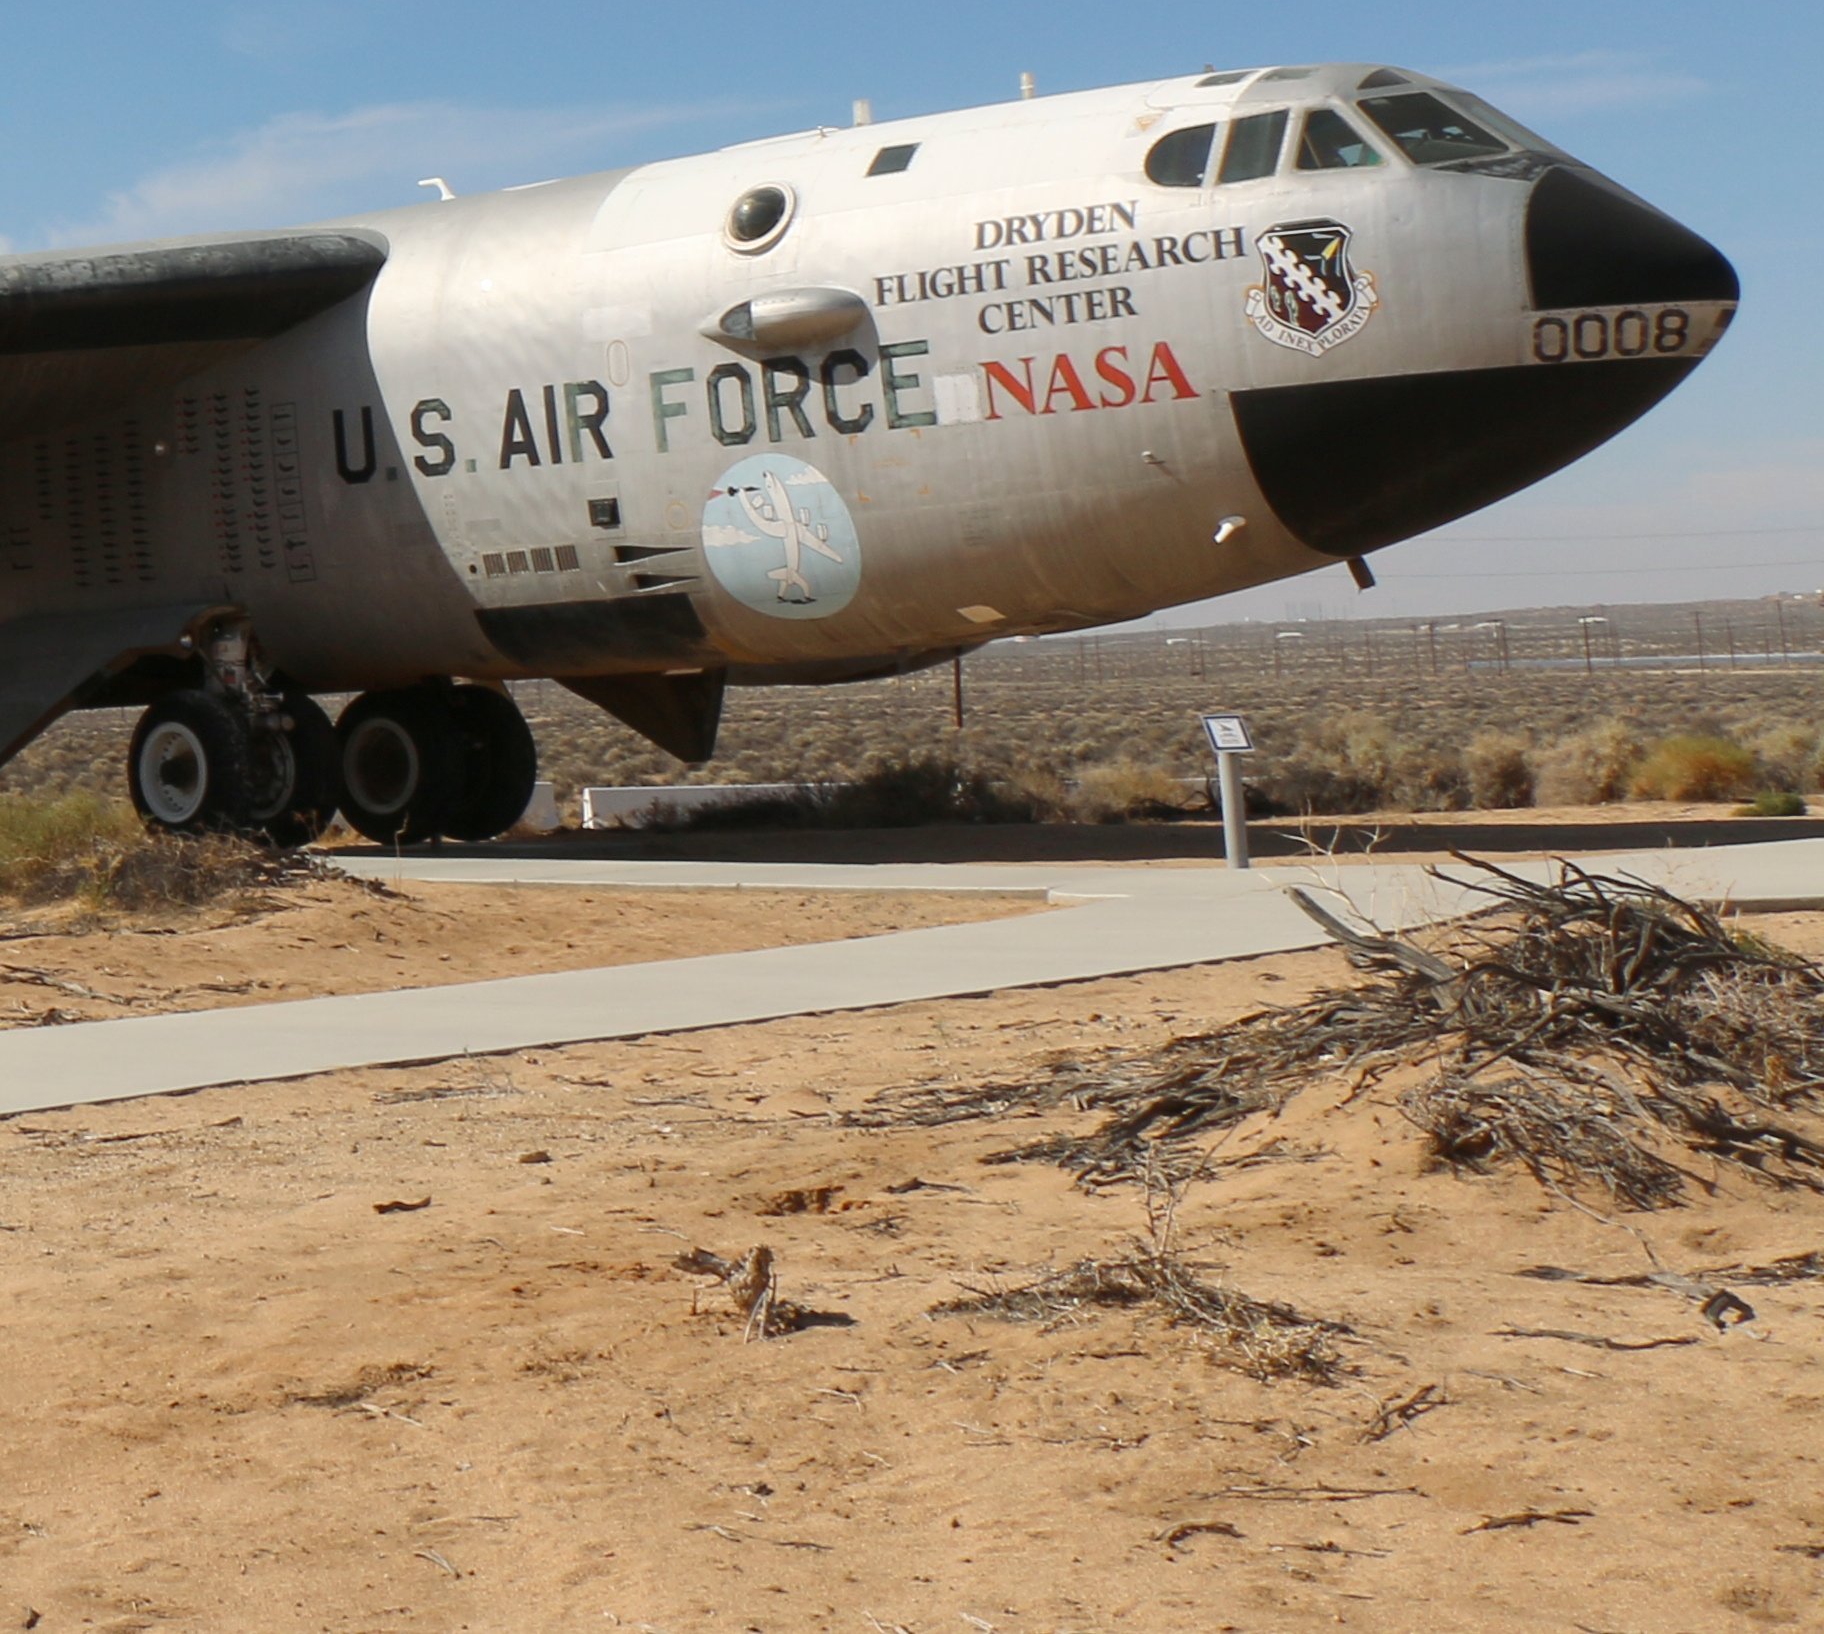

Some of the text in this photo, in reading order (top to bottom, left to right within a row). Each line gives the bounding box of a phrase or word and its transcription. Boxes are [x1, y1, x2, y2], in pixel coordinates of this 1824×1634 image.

[974, 200, 1139, 250] DRYDEN
[873, 227, 1248, 307] FLIGHT RESEARCH
[979, 286, 1139, 334] CENTER
[1256, 315, 1274, 332] AD
[1533, 308, 1690, 363] 0008
[978, 341, 1200, 421] NASA
[333, 339, 938, 484] U.S. AIR FORCE
